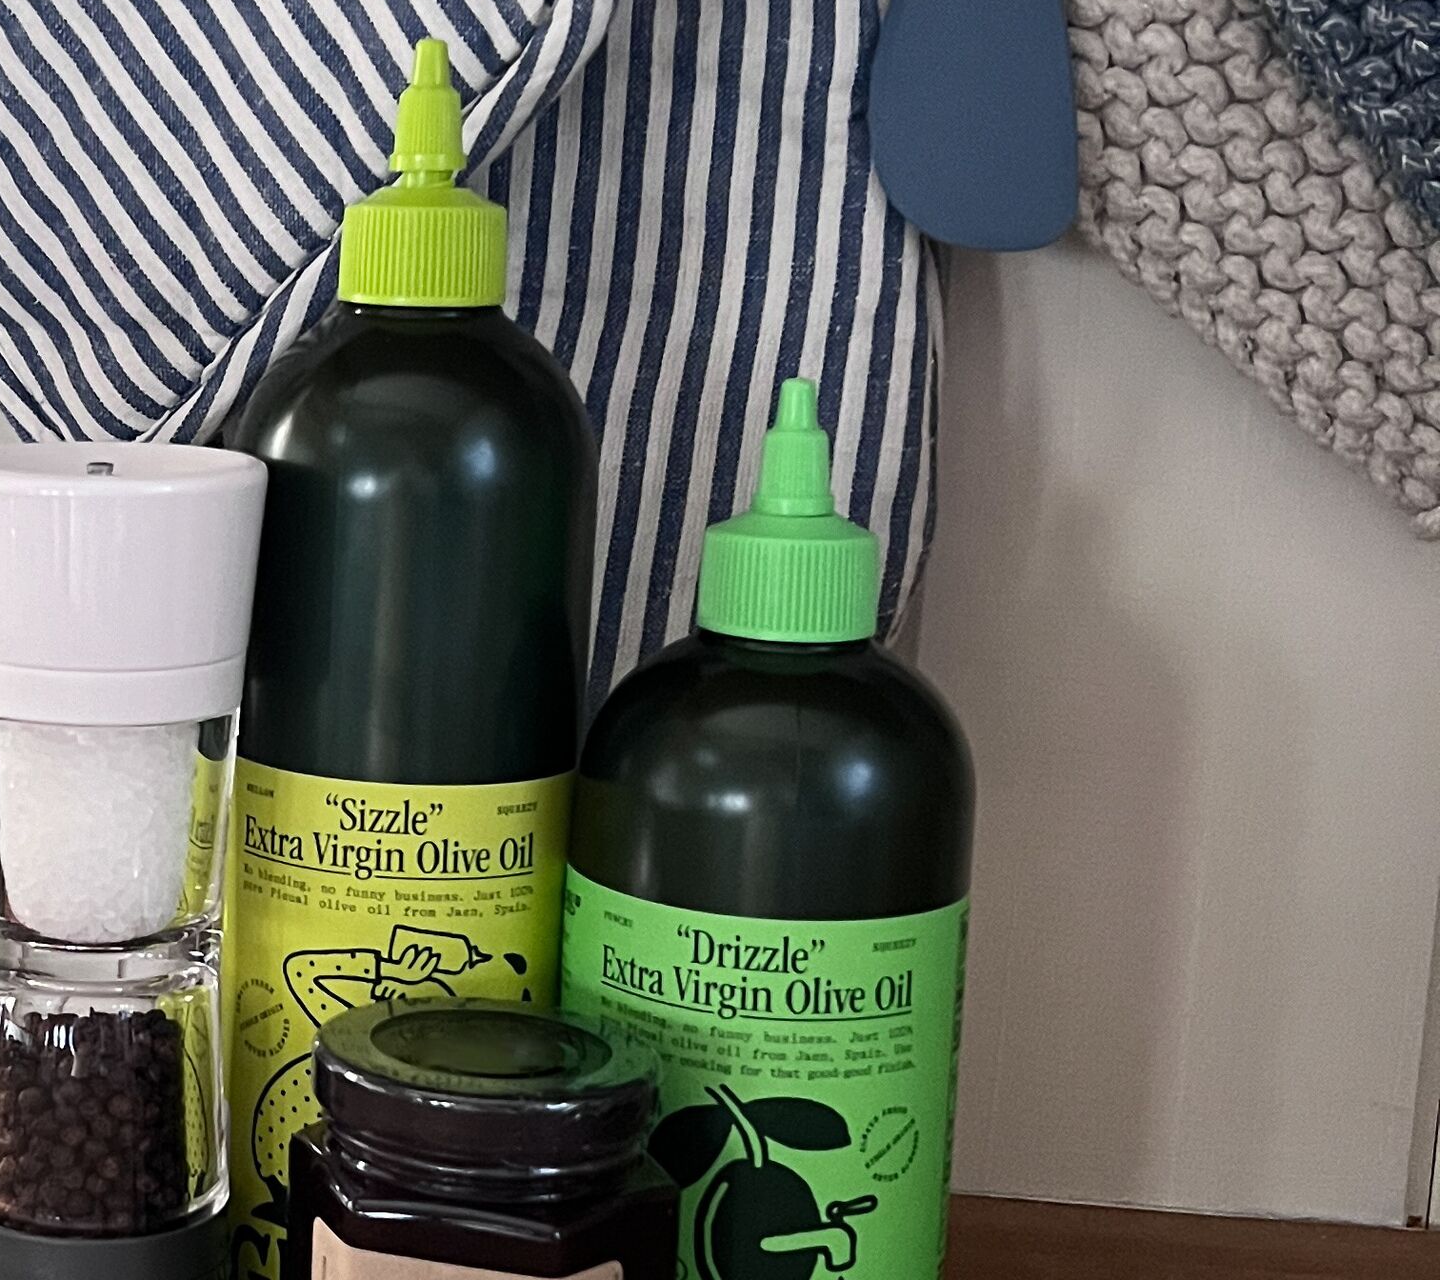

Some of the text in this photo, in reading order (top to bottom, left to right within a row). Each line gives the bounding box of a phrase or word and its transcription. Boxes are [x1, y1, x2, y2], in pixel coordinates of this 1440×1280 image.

[326, 793, 443, 836] “Sizzle”
[244, 814, 534, 881] Extra Virgin Olive Oil
[321, 884, 336, 895] no
[345, 886, 386, 902] funny
[395, 890, 464, 902] business.
[319, 898, 357, 913] olive
[367, 904, 391, 916] oil
[403, 906, 436, 918] from
[677, 924, 825, 974] “Drizzle”
[602, 944, 912, 1020] Extra Virgin Olive Oil
[710, 1026, 753, 1043] funny
[671, 1035, 708, 1052] olive
[717, 1044, 741, 1058] oil
[753, 1048, 787, 1061] from
[770, 1068, 800, 1079] that
